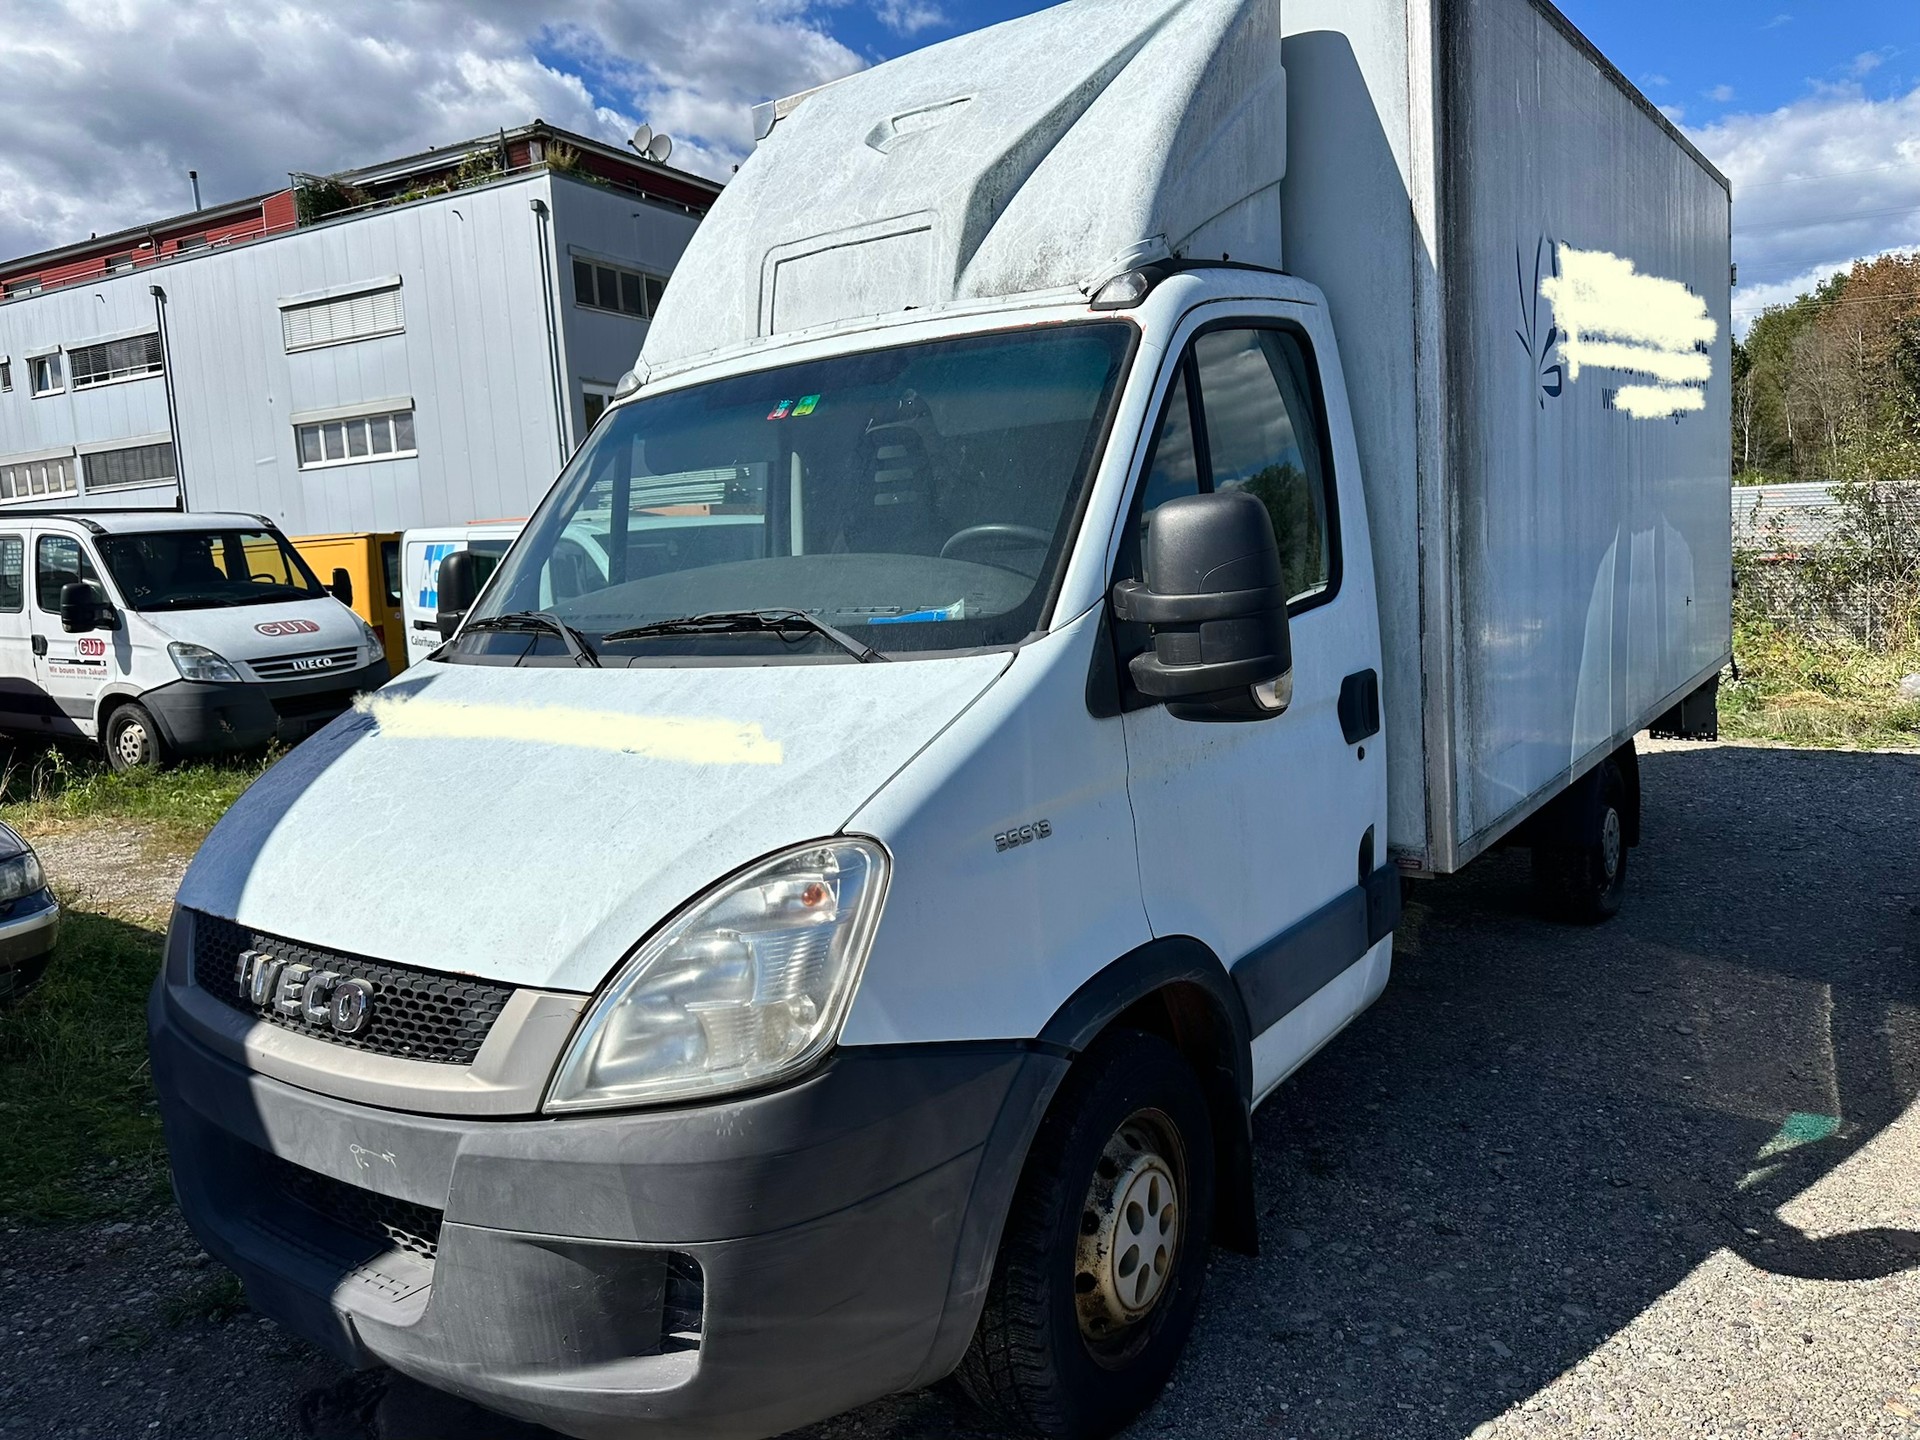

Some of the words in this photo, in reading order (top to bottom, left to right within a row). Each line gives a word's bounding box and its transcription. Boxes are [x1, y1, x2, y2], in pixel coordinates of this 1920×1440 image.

[257, 621, 312, 634] GUT
[80, 640, 101, 654] GUT
[292, 658, 333, 671] IVECO
[994, 819, 1052, 853] 35S13
[234, 950, 374, 1033] IVECO
